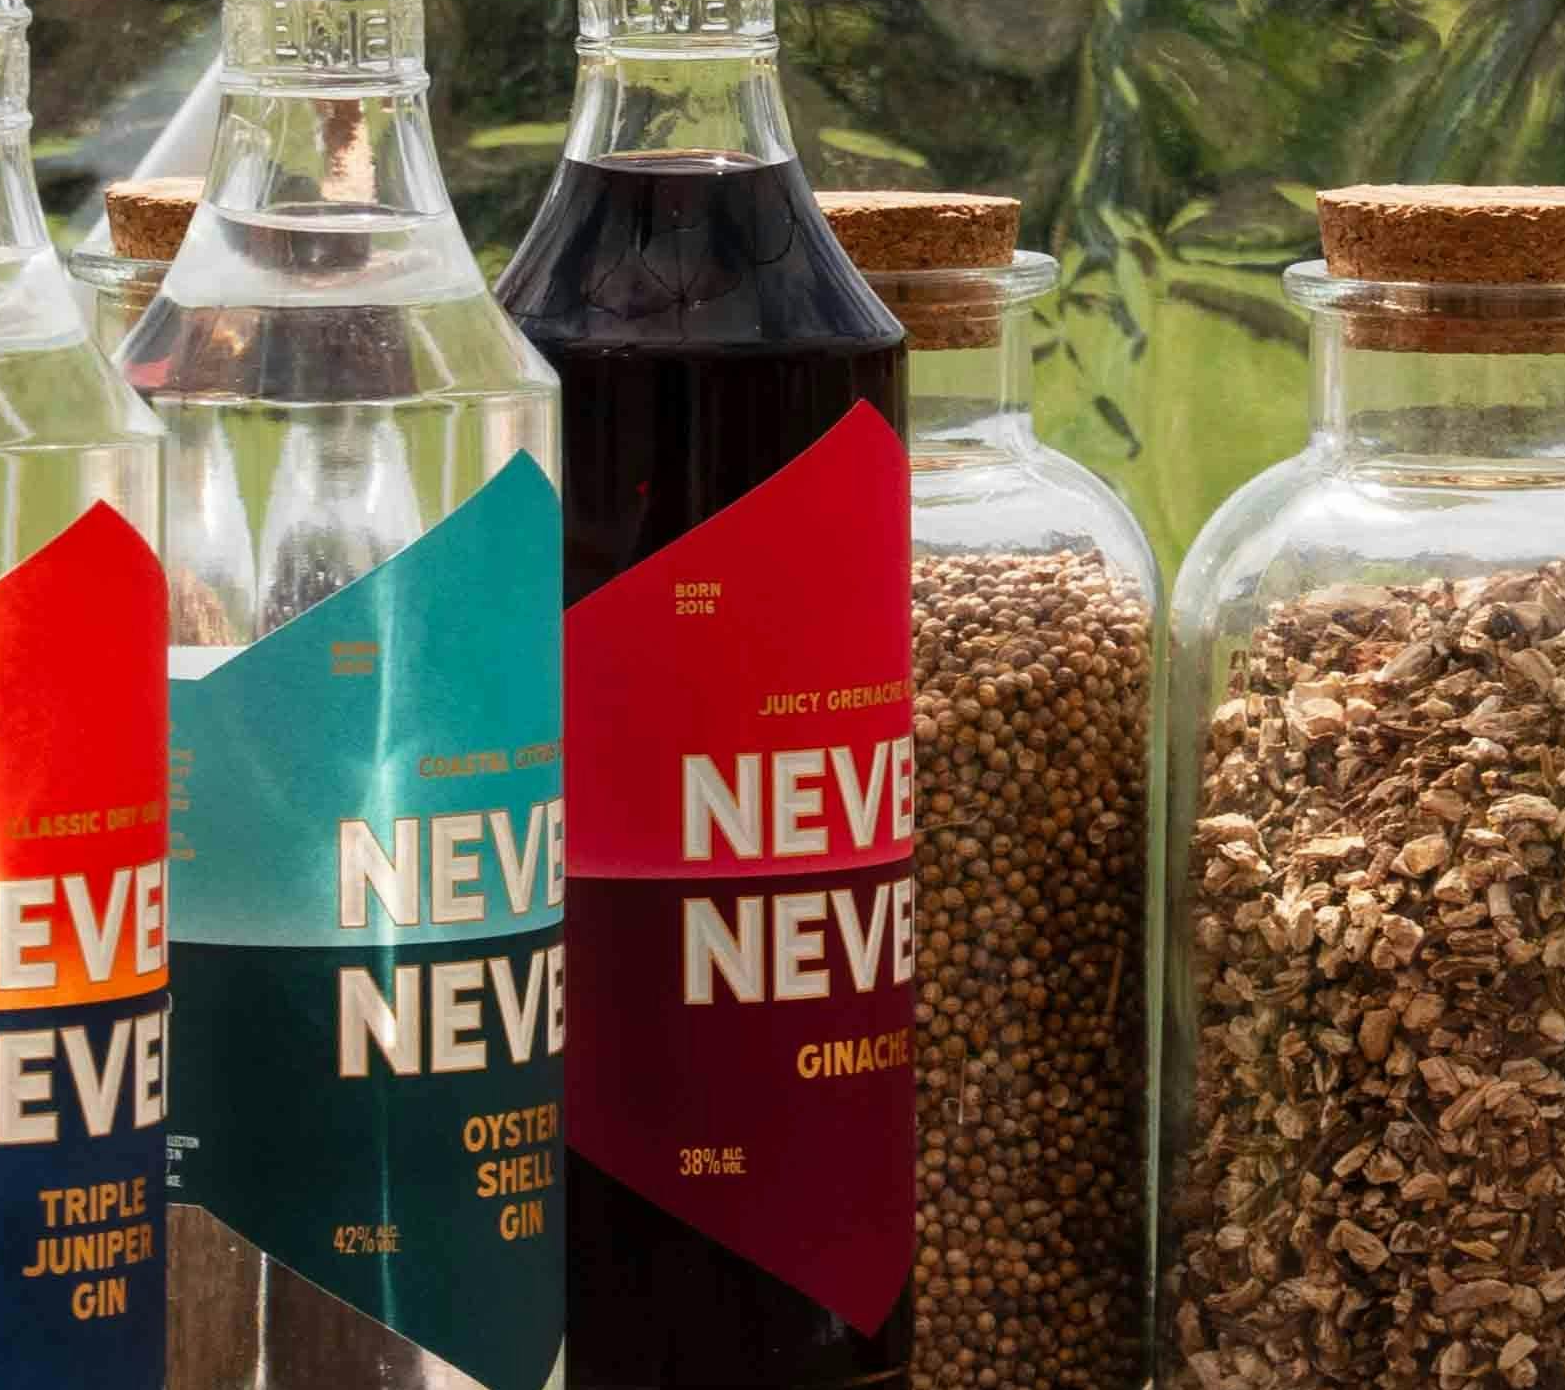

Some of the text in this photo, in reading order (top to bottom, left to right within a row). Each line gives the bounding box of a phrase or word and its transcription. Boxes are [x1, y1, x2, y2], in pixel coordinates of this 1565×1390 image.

[675, 582, 722, 598] BORN
[675, 600, 716, 615] 2016
[757, 681, 903, 716] JUICY GRENACHE
[681, 736, 916, 861] NEVE
[7, 810, 101, 840] CLASSIC
[683, 878, 916, 1007] NEVE
[796, 1027, 909, 1079] GINACHE
[463, 1102, 558, 1152] OYSTER
[476, 1152, 554, 1198] SHELL
[679, 1147, 721, 1176] 38%
[38, 1176, 147, 1228] TRIPLE
[499, 1200, 544, 1241] GIN
[21, 1223, 155, 1278] JUNIPER
[333, 1224, 374, 1254] 42%
[71, 1276, 129, 1321] GIN
